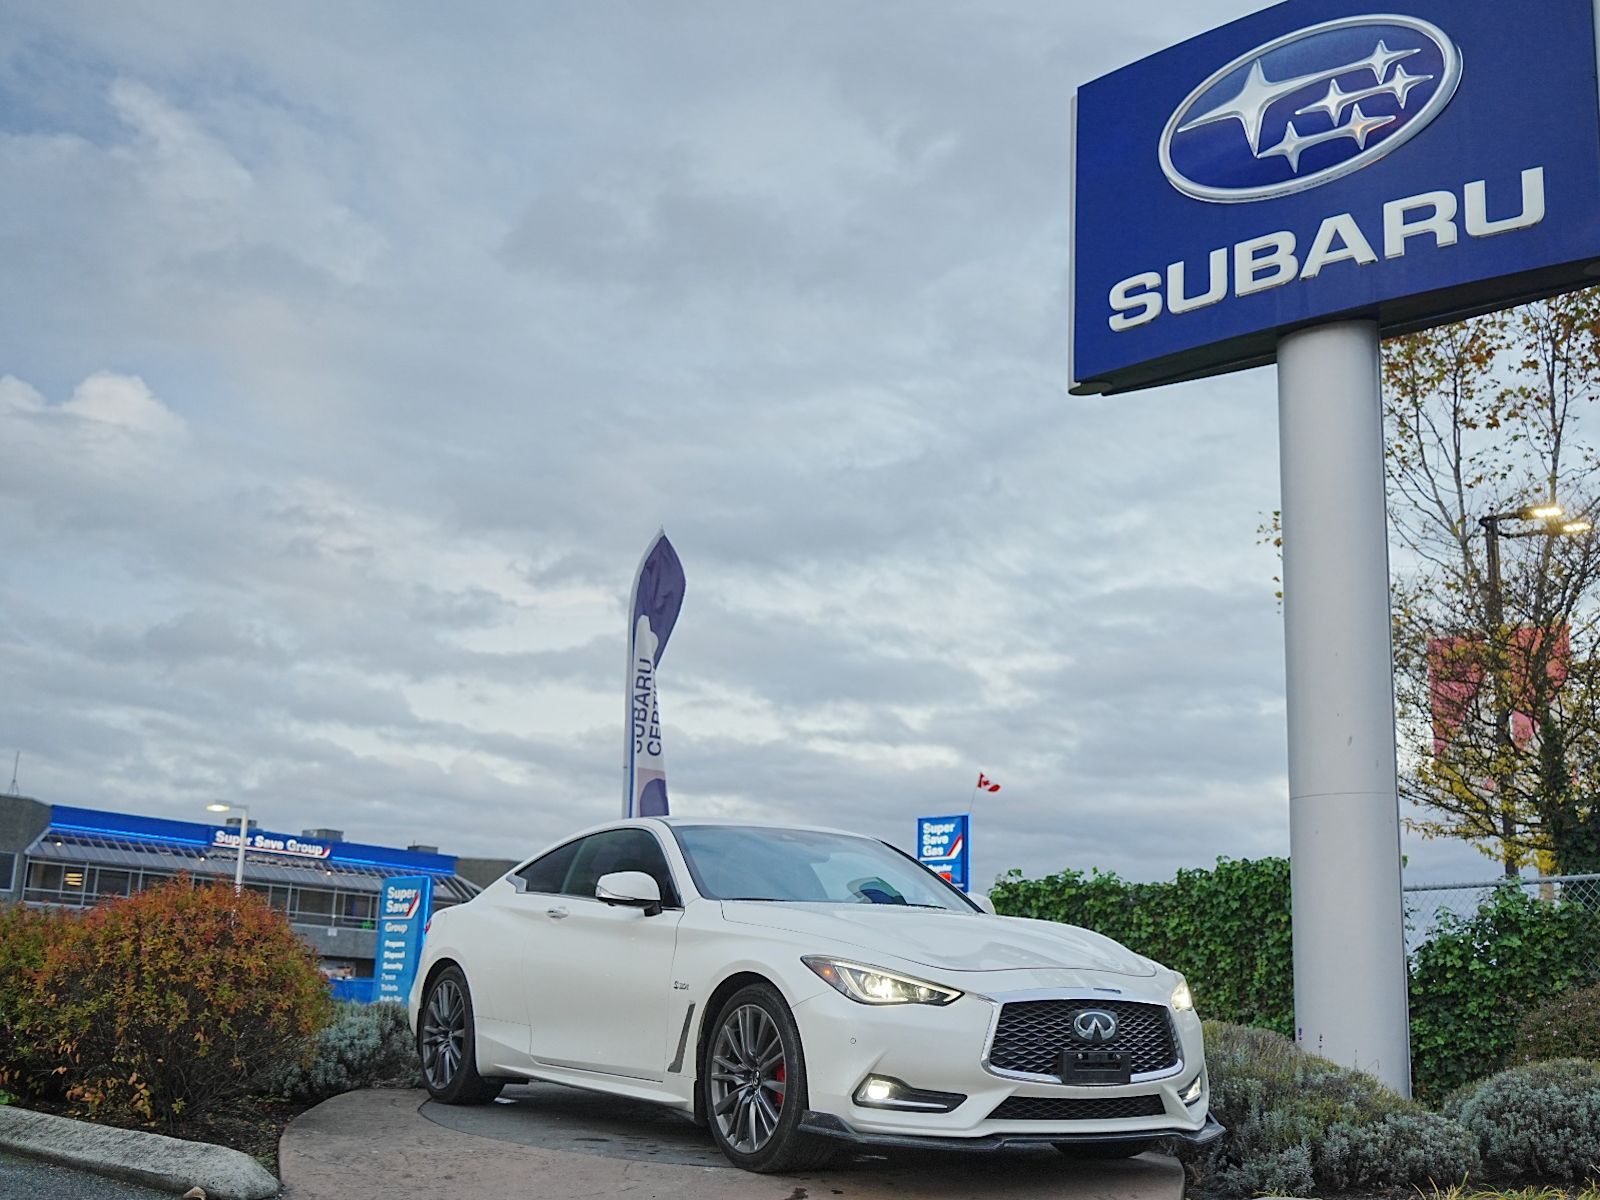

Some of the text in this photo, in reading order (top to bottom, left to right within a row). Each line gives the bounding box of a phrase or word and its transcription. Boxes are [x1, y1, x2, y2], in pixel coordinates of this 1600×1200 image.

[1108, 166, 1546, 333] SUBARU
[922, 823, 956, 835] Super
[215, 830, 324, 856] Supr Save Group
[922, 834, 949, 845] Save
[922, 845, 944, 857] Gas
[387, 886, 418, 901] Super
[386, 900, 410, 913] Save
[385, 922, 408, 934] Group
